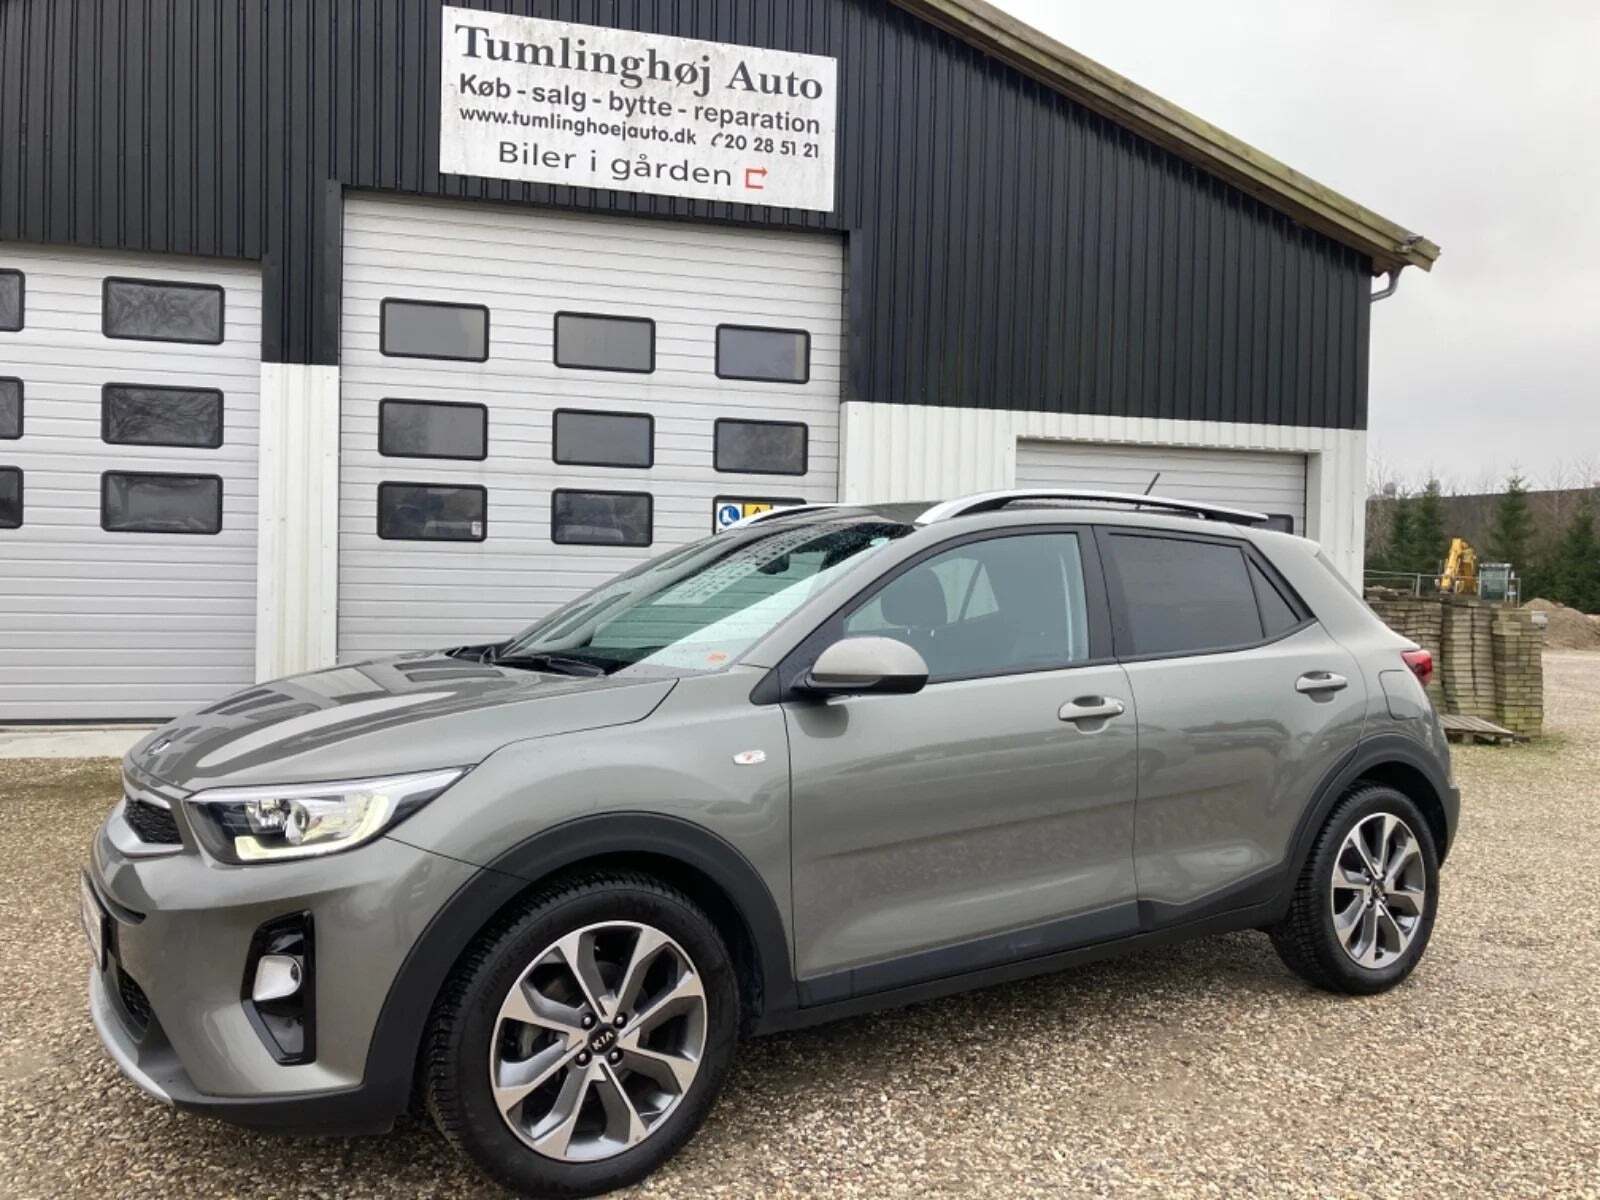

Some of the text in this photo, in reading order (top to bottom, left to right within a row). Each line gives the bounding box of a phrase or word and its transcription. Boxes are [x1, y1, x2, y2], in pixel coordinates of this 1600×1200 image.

[455, 24, 822, 99] Tumlinghøj Auto
[460, 73, 511, 98] Køb
[532, 84, 586, 112] salg
[609, 90, 672, 117] bytte
[694, 105, 820, 135] reparation
[459, 107, 819, 158] www.tumlinghoejauto.dk 20 28 51 21
[499, 141, 731, 186] Biler i gården
[591, 1031, 614, 1050] KIA
